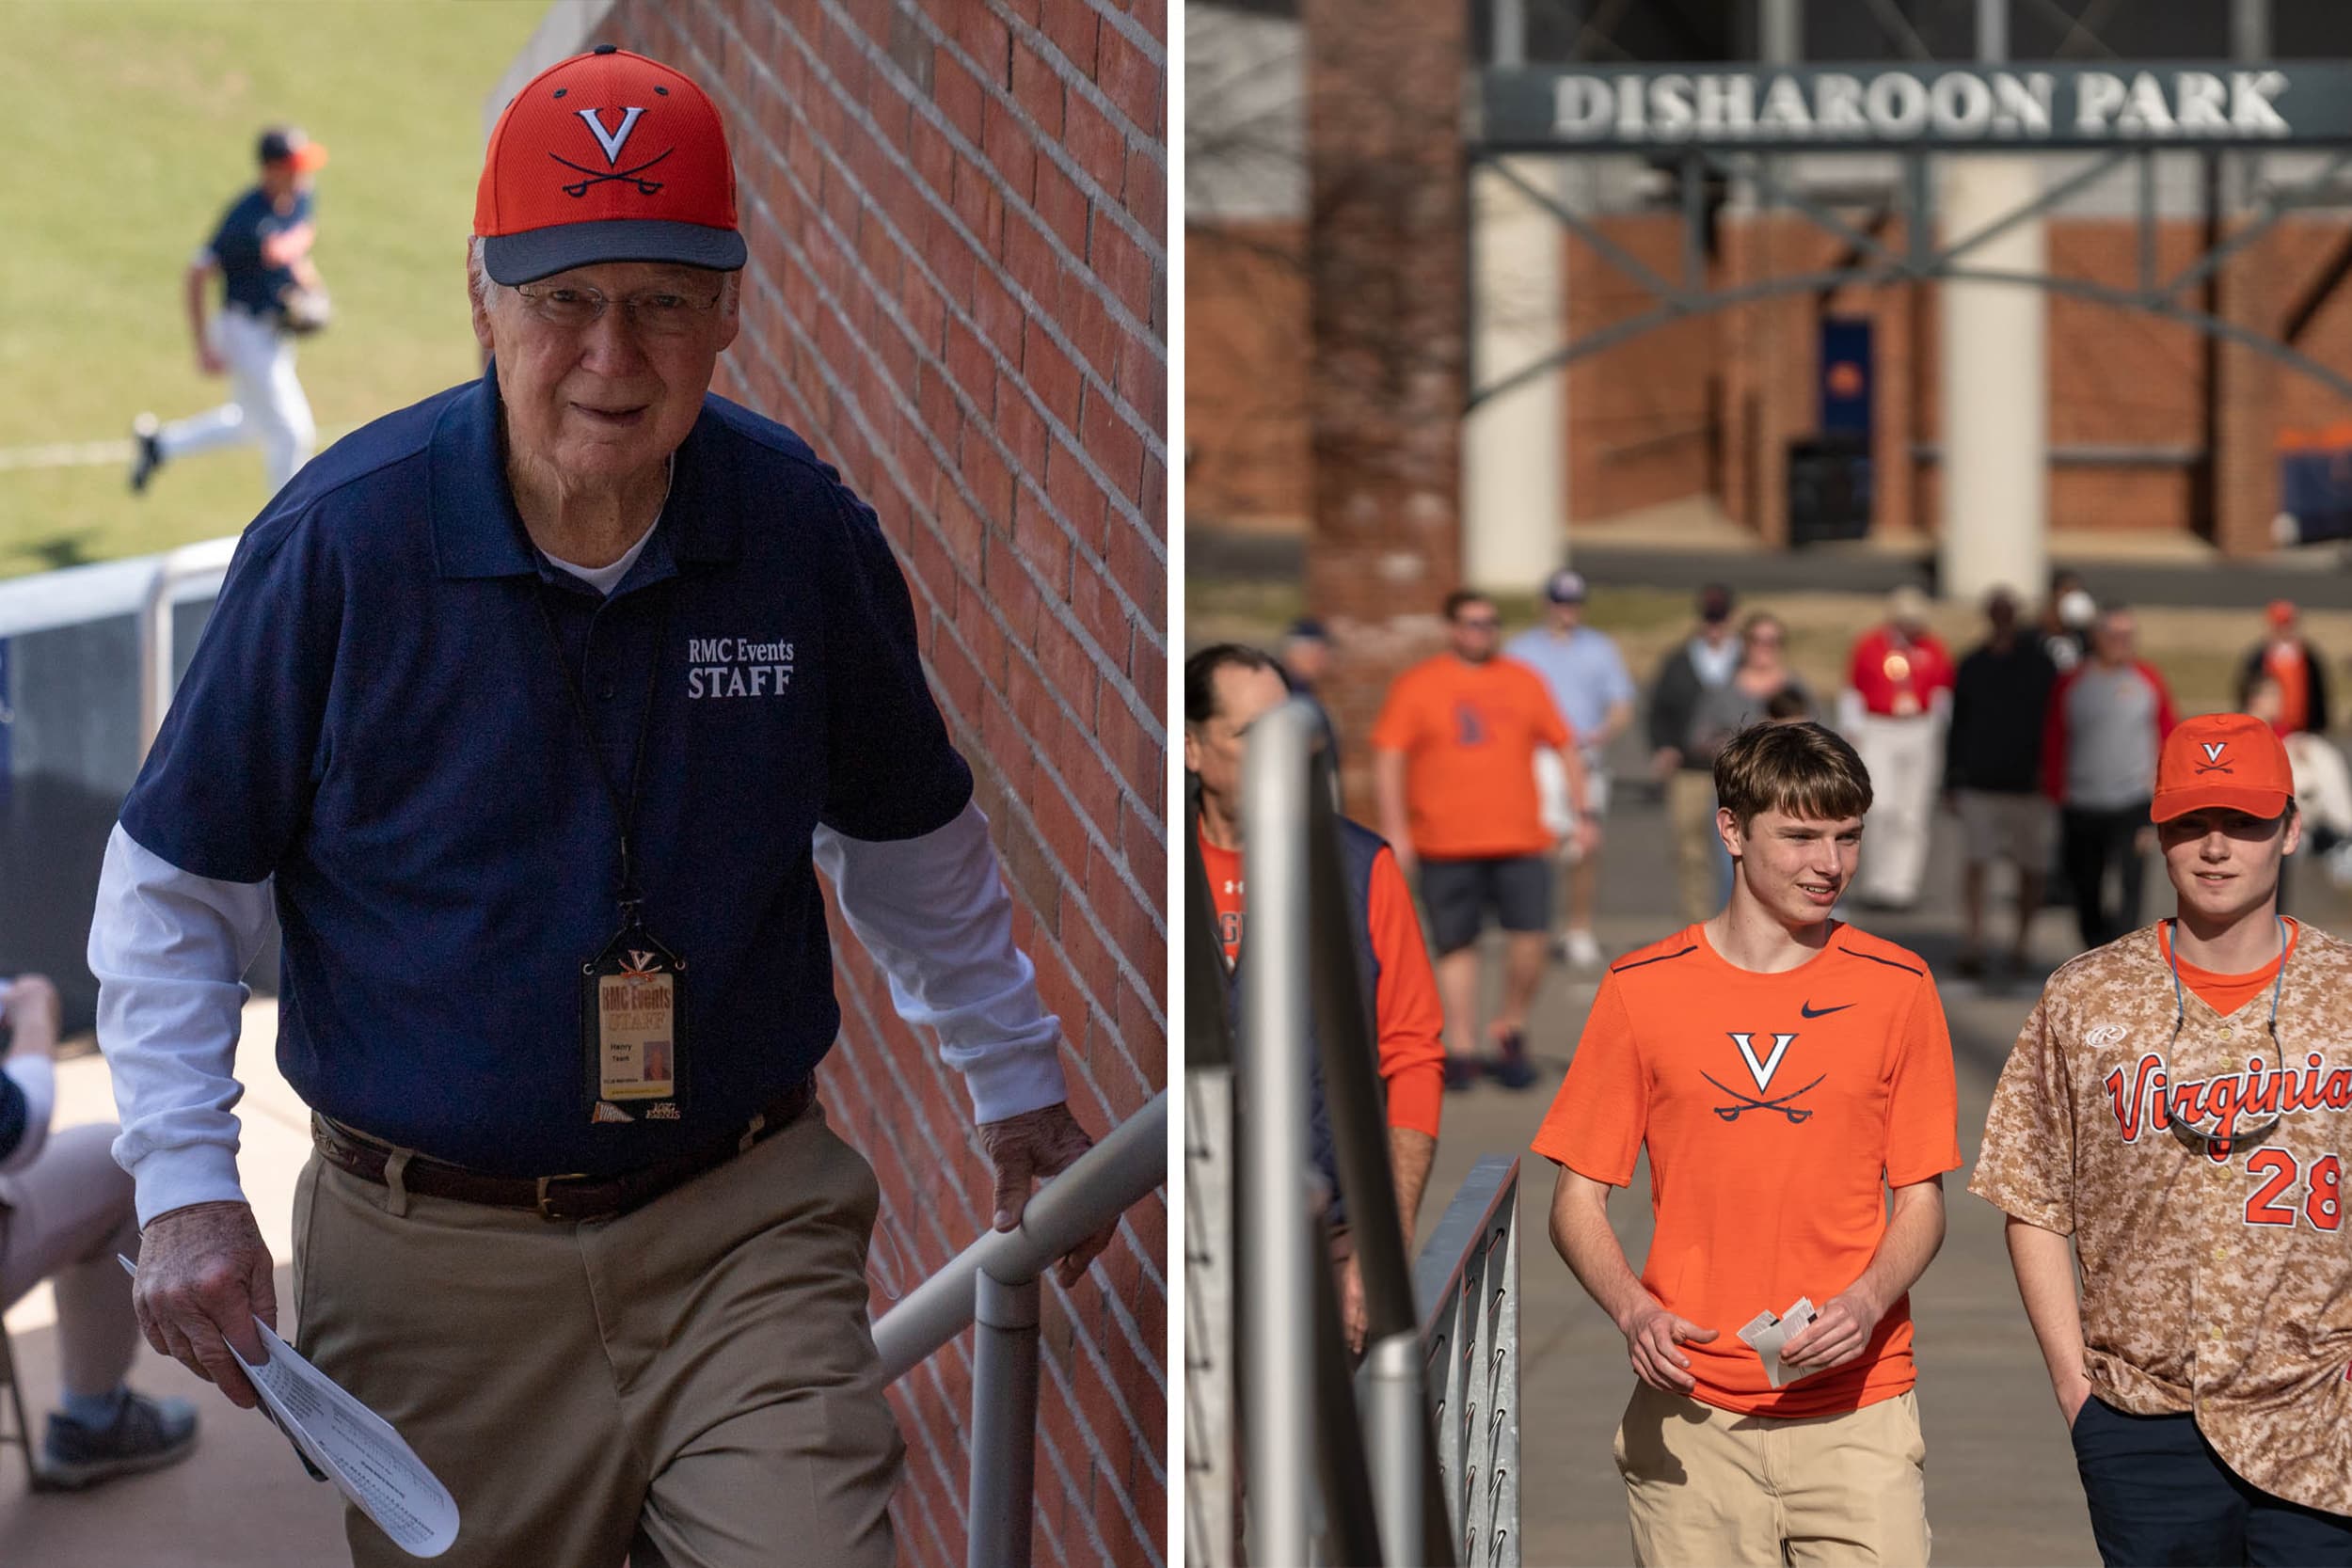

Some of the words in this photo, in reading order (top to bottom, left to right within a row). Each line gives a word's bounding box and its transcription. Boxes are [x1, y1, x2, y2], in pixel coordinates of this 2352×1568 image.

[1552, 71, 2055, 140] DISHAROON
[2075, 70, 2292, 138] PARK
[573, 106, 649, 168] V
[689, 638, 732, 662] RMC
[738, 638, 794, 661] Events
[688, 665, 794, 699] STAFF
[2201, 742, 2228, 764] V
[602, 986, 629, 1011] RMC
[631, 986, 671, 1010] Events
[1725, 1032, 1800, 1096] V
[2103, 1053, 2352, 1164] Virginia
[2243, 1146, 2344, 1232] 28
